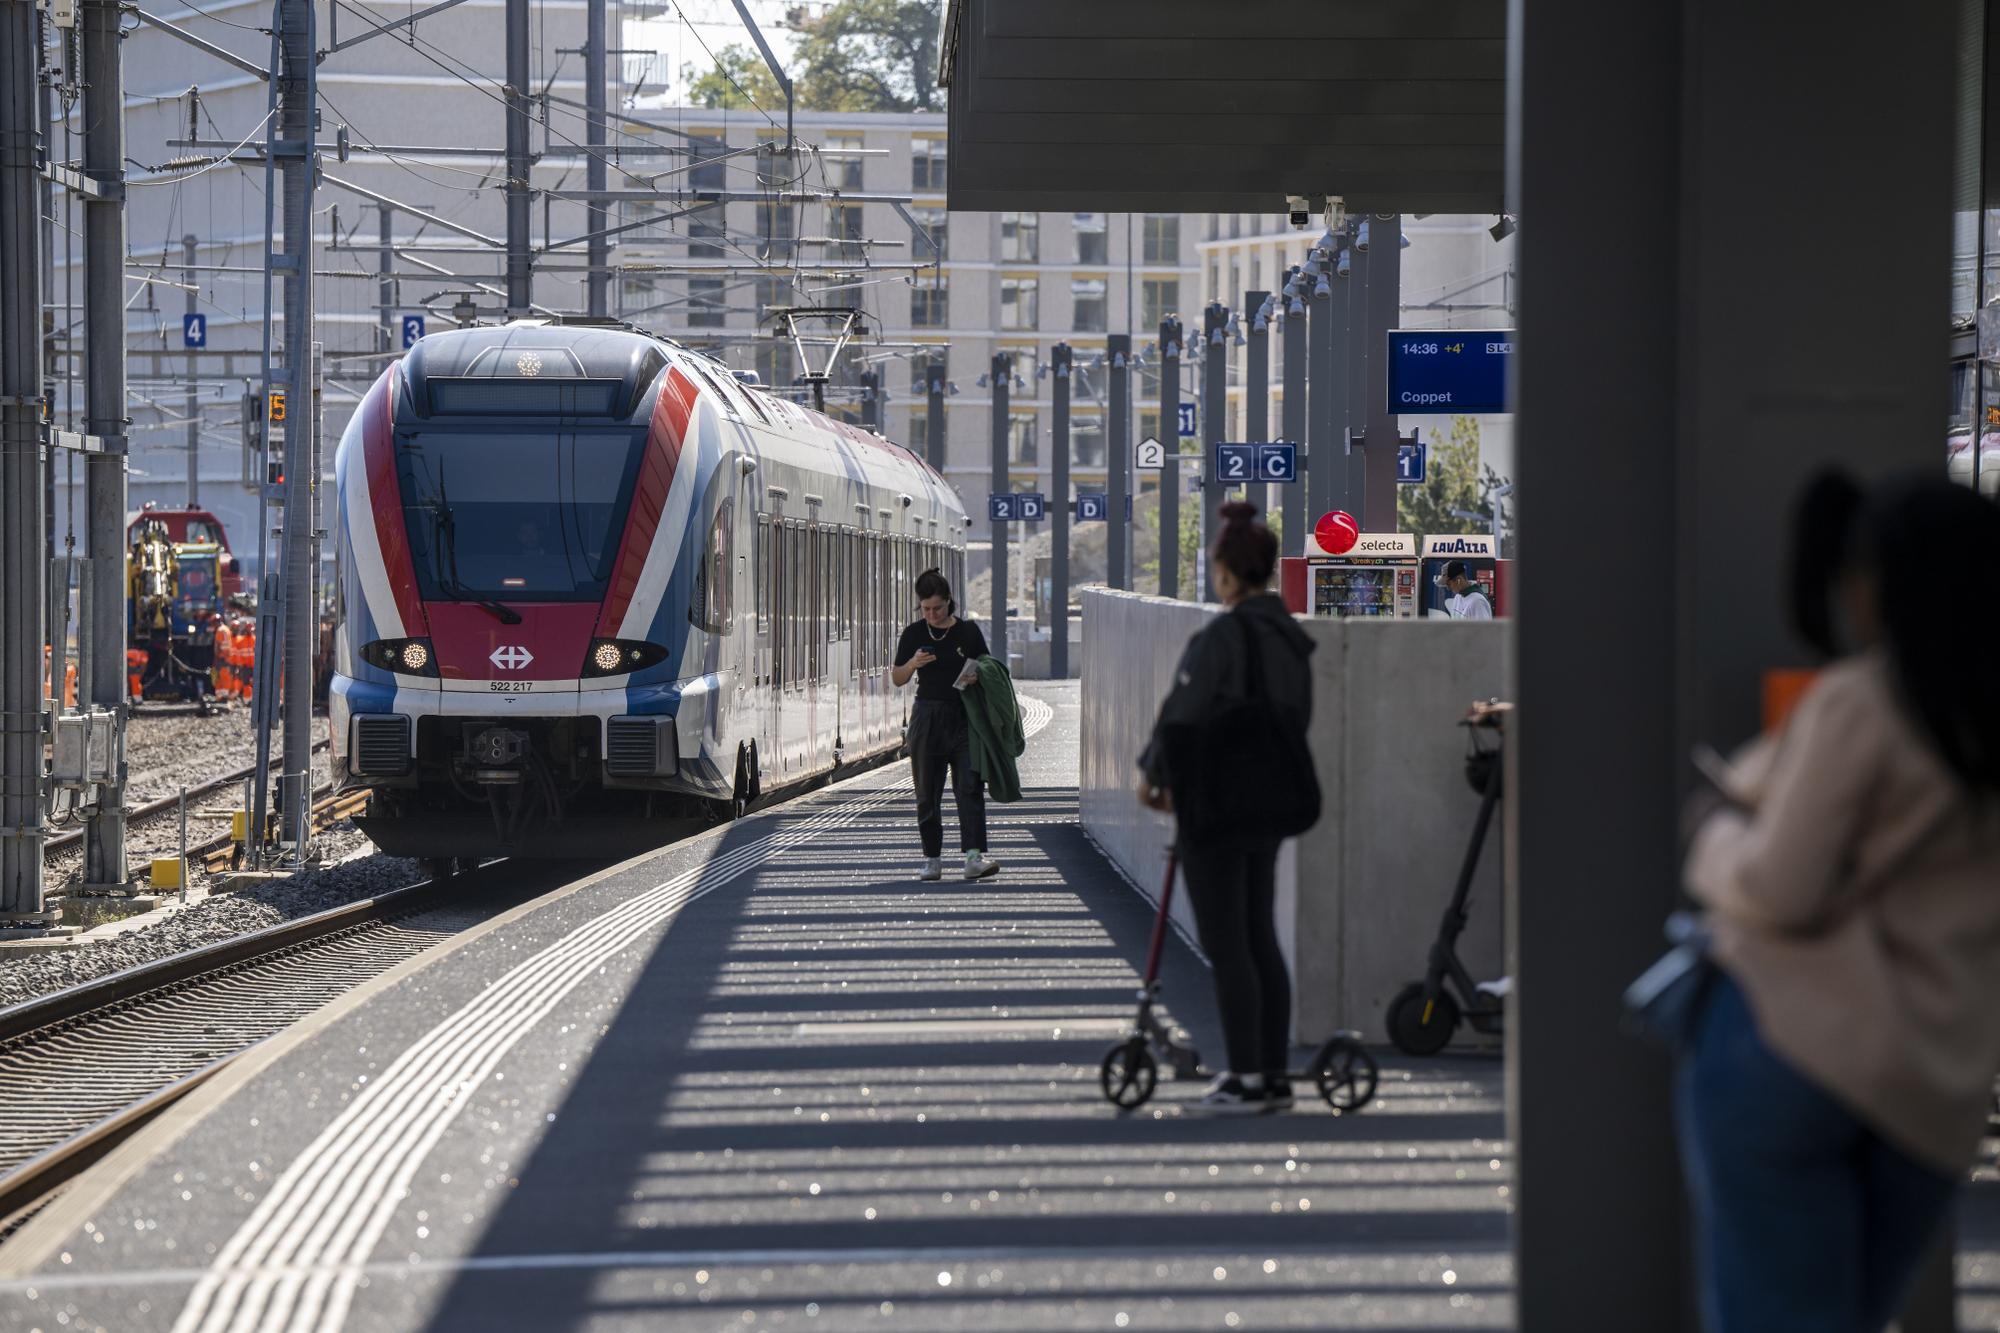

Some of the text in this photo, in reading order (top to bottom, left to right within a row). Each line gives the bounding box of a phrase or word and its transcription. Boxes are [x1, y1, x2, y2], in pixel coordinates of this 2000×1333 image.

[188, 319, 202, 342] 4
[406, 320, 420, 344] 3
[1402, 343, 1438, 354] 14:36
[1487, 343, 1511, 353] SL4
[1401, 391, 1452, 404] Coppet
[1145, 446, 1157, 464] 2
[1228, 455, 1286, 476] 2 C
[1399, 456, 1410, 476] 1
[997, 502, 1037, 517] 2 D
[1084, 503, 1097, 517] D
[1360, 540, 1404, 551] selecta
[1431, 538, 1488, 553] LAVAZZA
[490, 682, 533, 691] 522 217
